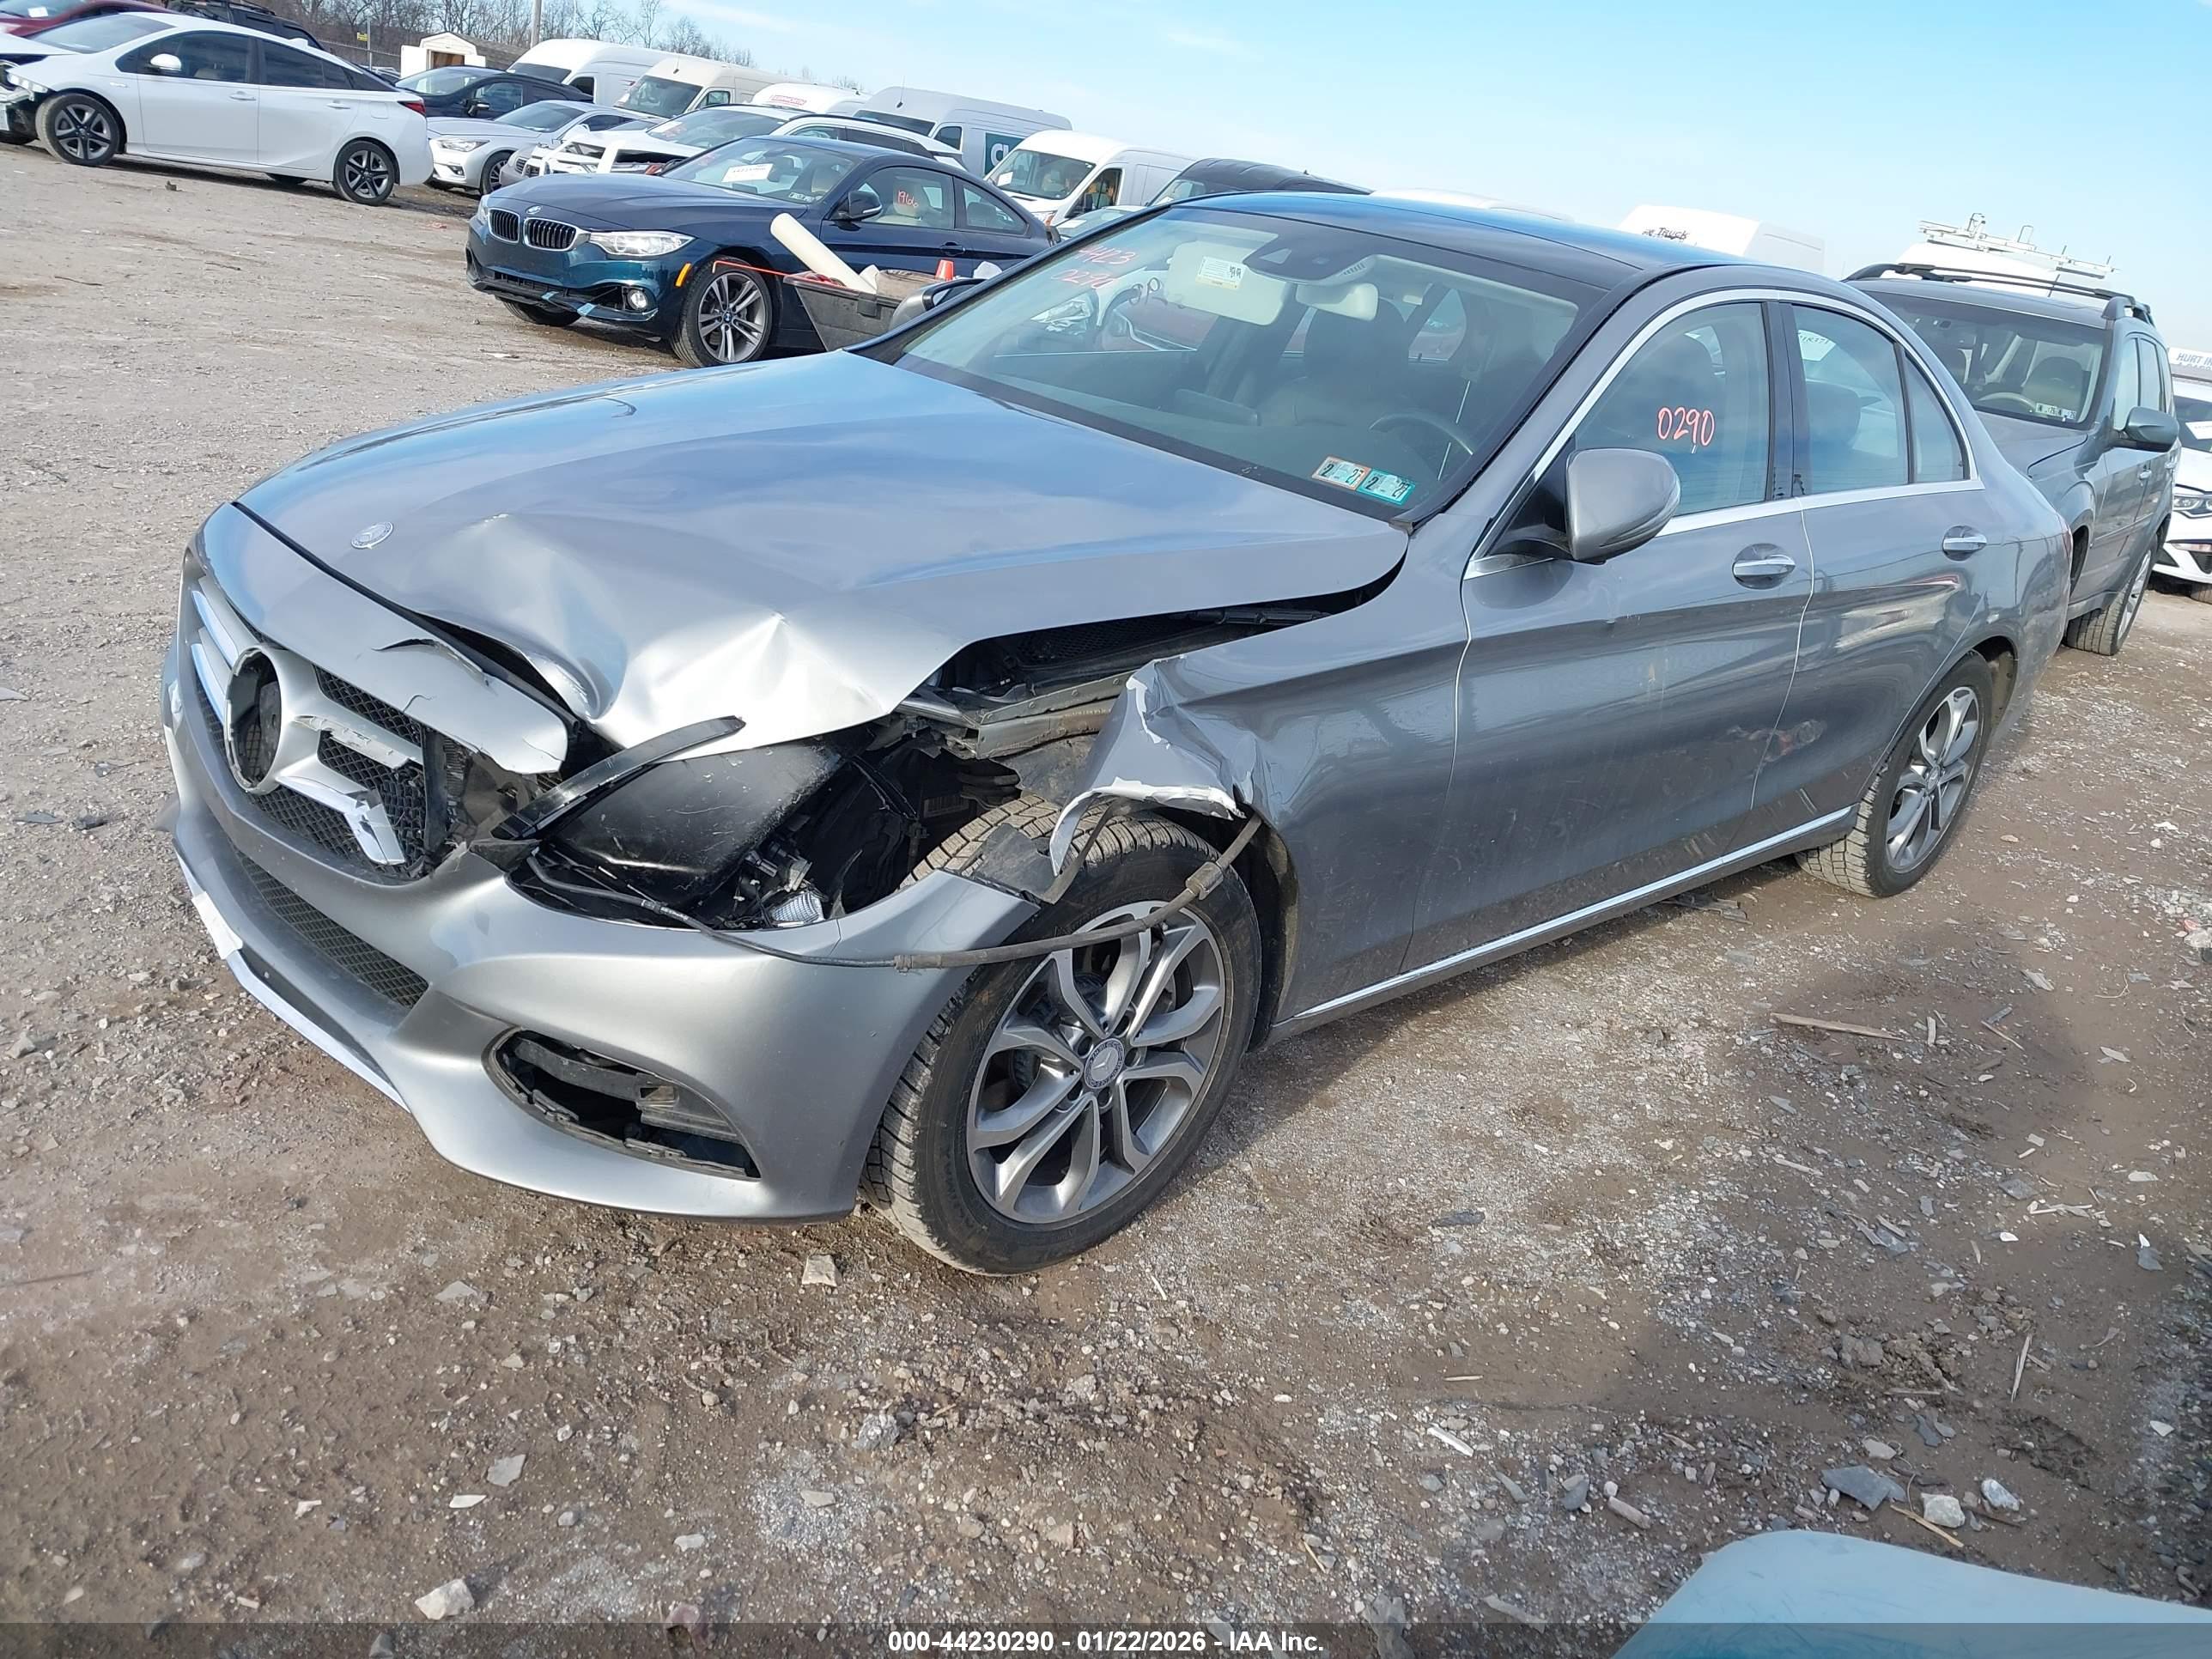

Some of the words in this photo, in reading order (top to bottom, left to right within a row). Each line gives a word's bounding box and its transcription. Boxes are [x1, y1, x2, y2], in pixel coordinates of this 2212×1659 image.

[2176, 352, 2203, 364] HURT
[1657, 406, 1716, 447] 0290
[1365, 476, 1379, 490] 2
